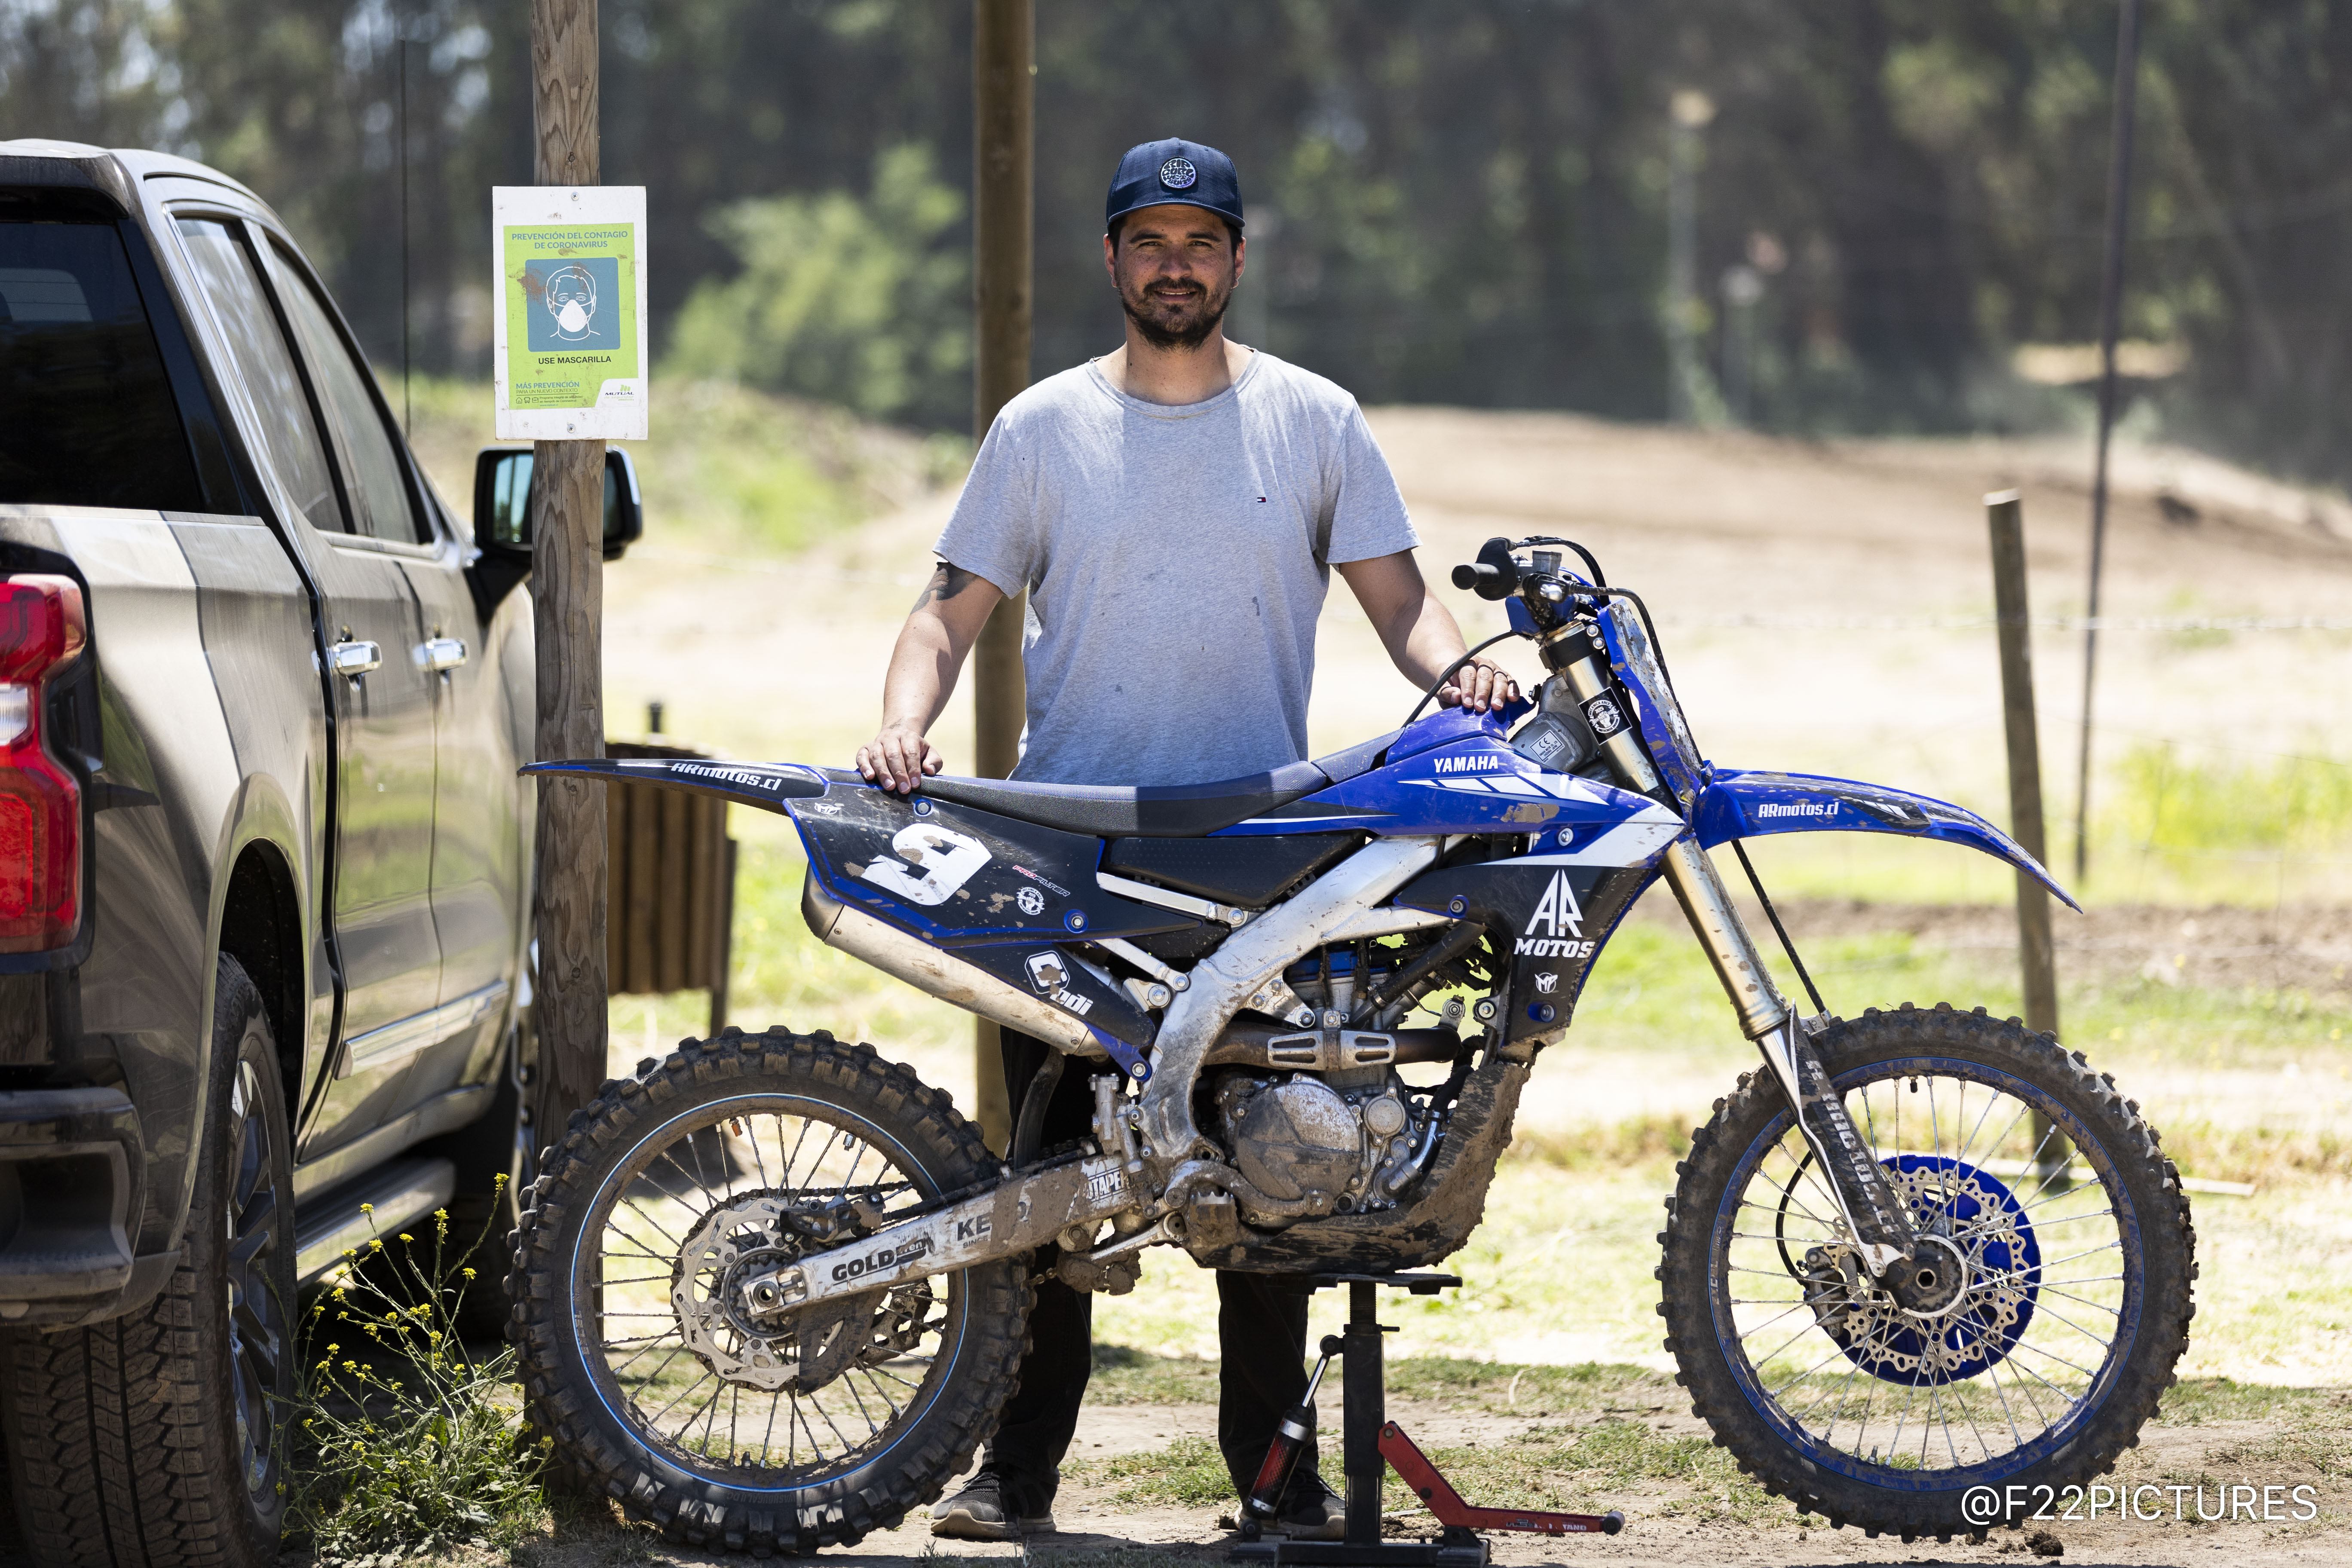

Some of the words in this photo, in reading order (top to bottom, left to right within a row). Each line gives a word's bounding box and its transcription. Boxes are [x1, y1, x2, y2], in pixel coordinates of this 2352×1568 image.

[1164, 159, 1191, 169] RIP
[1162, 168, 1194, 178] CURL
[1167, 177, 1191, 185] SUITS
[512, 231, 565, 240] PREVENCIÓN
[547, 241, 608, 249] CORONAVIRUS
[533, 380, 579, 389] PREVENCIÓN
[1539, 737, 1550, 748] CE
[1434, 756, 1498, 773] YAMAHA
[671, 763, 782, 791] ARmotos.cl
[1758, 802, 1839, 818] ARmotos.cl
[861, 823, 992, 906] 9
[1012, 865, 1071, 897] PROFILTER
[1525, 869, 1583, 937] AR
[1513, 938, 1596, 958] MOTOS
[1562, 1523, 1587, 1531] TAND
